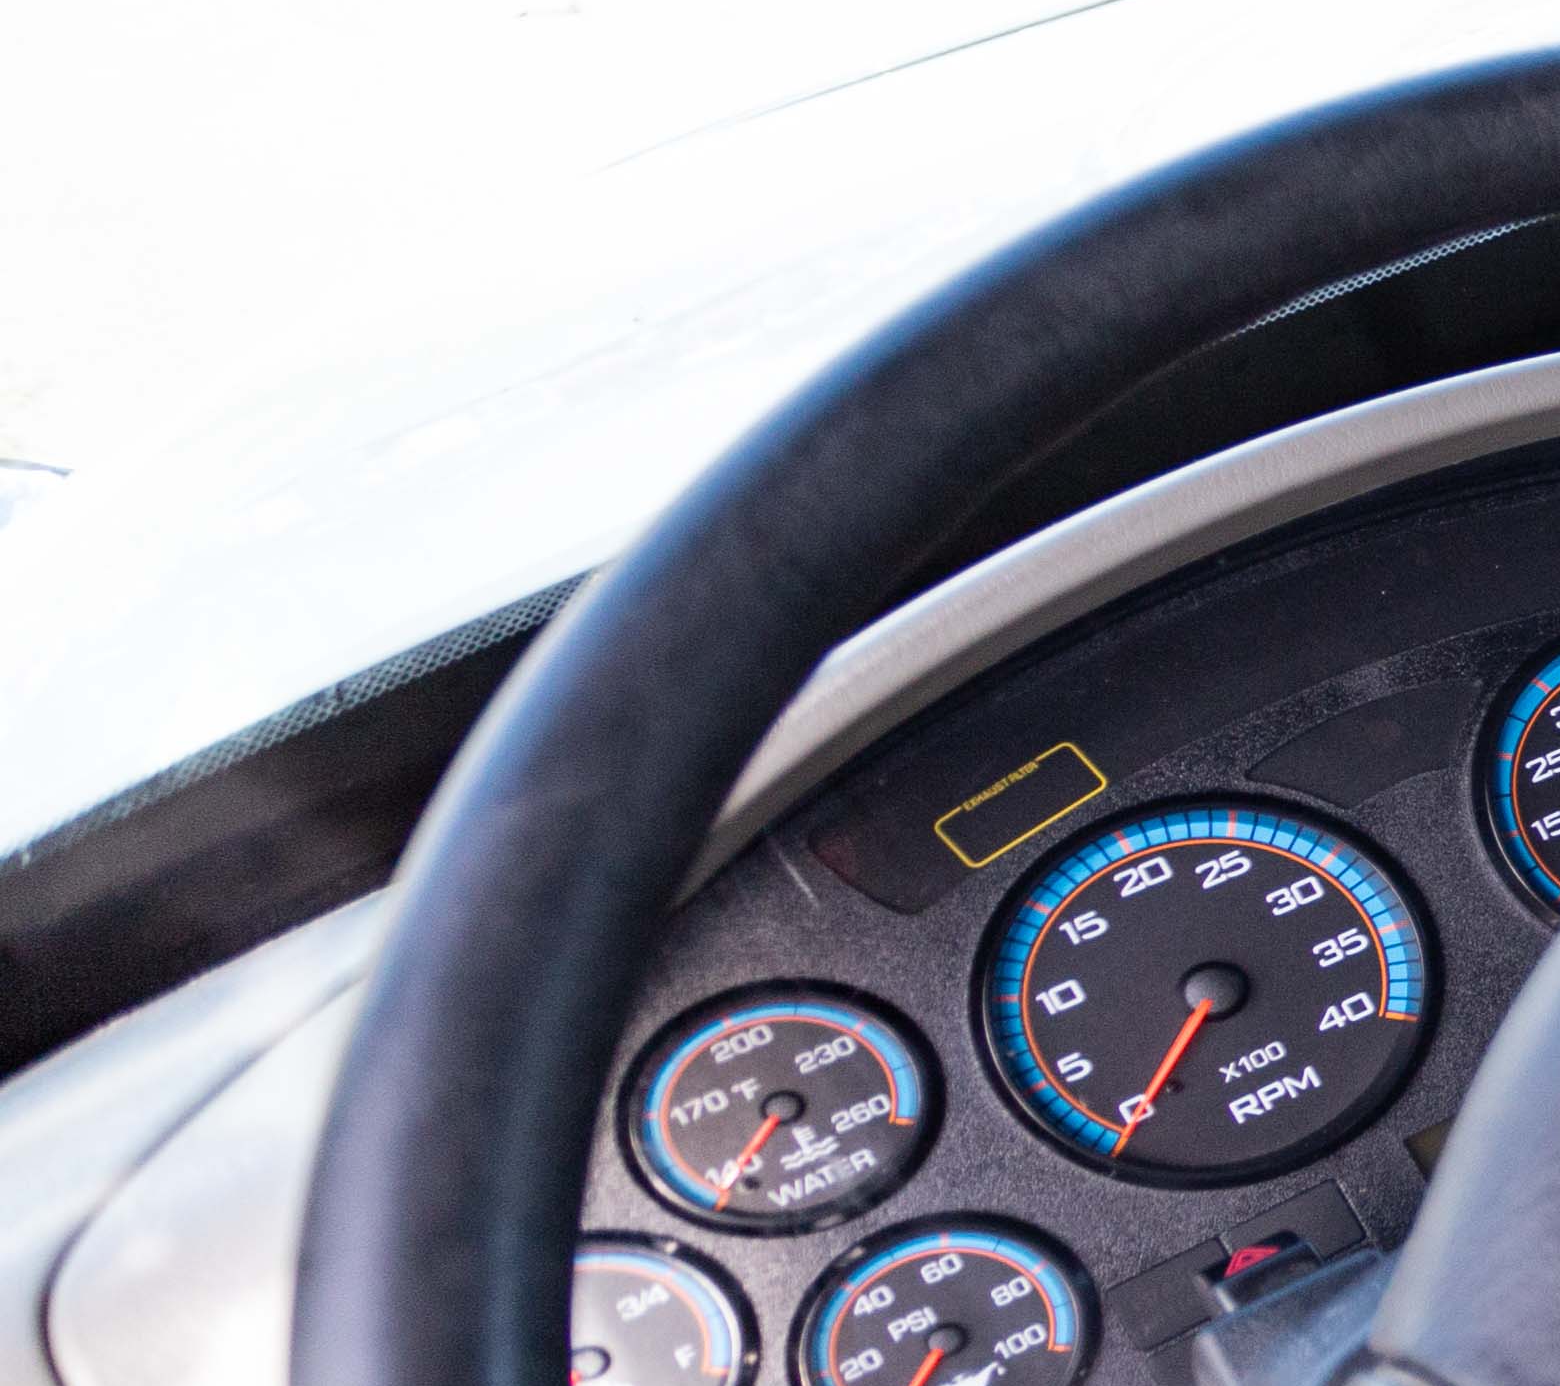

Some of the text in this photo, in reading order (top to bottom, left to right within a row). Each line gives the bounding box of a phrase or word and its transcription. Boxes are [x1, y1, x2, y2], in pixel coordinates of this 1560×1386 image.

[1113, 856, 1173, 898] 20
[1195, 850, 1252, 890] 25
[1266, 876, 1325, 916] 30
[1059, 910, 1109, 945] 15
[1312, 928, 1370, 967] 35
[1036, 979, 1086, 1014] 10
[1319, 992, 1375, 1031] 40
[710, 1024, 774, 1064] 200
[795, 1035, 856, 1074] 230
[1219, 1040, 1287, 1083] X100
[1057, 1052, 1093, 1082] 5
[670, 1089, 729, 1126] 170
[831, 1094, 890, 1133] 260
[1119, 1094, 1155, 1124] 0
[1229, 1065, 1322, 1124] RPM
[767, 1147, 877, 1207] WATER
[920, 1253, 963, 1284] 60
[616, 1282, 670, 1322] 3/4
[854, 1285, 895, 1316] 40
[991, 1275, 1032, 1307] 80
[888, 1306, 937, 1343] PSI
[994, 1323, 1047, 1360] 100
[674, 1344, 696, 1369] F
[839, 1348, 883, 1383] 20
